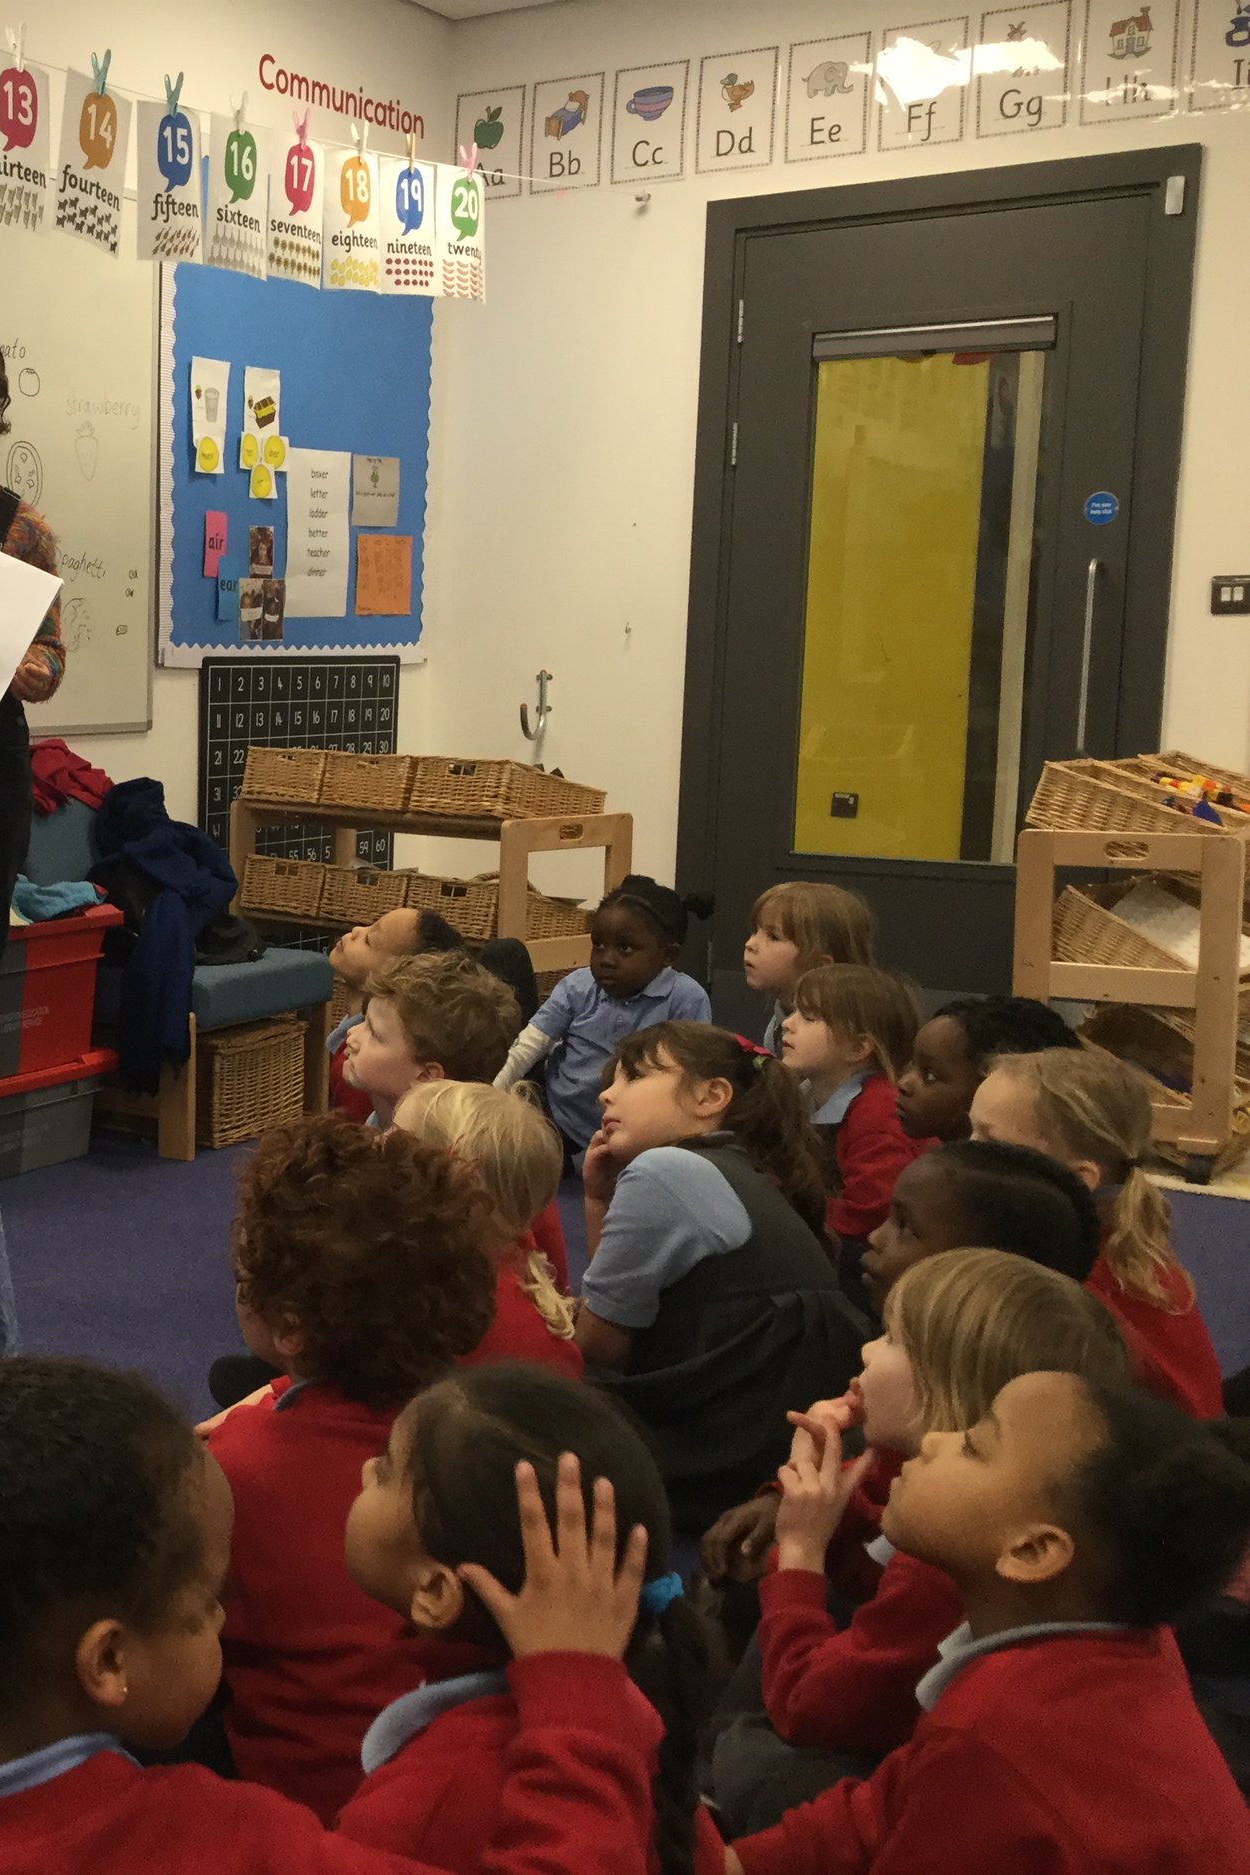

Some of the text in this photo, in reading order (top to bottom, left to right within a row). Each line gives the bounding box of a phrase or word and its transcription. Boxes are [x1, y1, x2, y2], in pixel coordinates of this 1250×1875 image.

[3, 80, 33, 126] 13
[258, 53, 425, 140] Communication
[999, 89, 1044, 126] Gg
[87, 103, 113, 149] 14
[810, 116, 842, 145] Ee
[907, 101, 938, 141] Ff
[162, 126, 190, 165] 15
[632, 139, 664, 167] Cc
[716, 126, 755, 157] Dd
[230, 141, 254, 181] 16
[289, 155, 313, 192] 17
[549, 150, 581, 178] Bb
[58, 163, 121, 212] fourteen
[345, 168, 370, 204] 18
[400, 178, 423, 212] 19
[151, 193, 199, 223] fifteen
[454, 186, 479, 221] 20
[216, 204, 261, 234] sixteen
[270, 218, 322, 245] seventeen
[331, 230, 379, 253] eighteen
[387, 238, 432, 257] nineteen
[310, 487, 329, 499] letter
[208, 534, 224, 551] air
[308, 528, 328, 538] better
[220, 578, 238, 592] ear
[217, 674, 390, 692] 1 2 3 4 5 6 7 8 9 10
[235, 713, 244, 728] 12
[255, 712, 264, 727] 13
[275, 711, 283, 726] 14
[294, 711, 302, 725] 15
[312, 710, 320, 724] 16
[331, 709, 338, 723] 17
[348, 708, 356, 722] 18
[365, 708, 373, 721] 19
[380, 707, 390, 721] 20
[214, 750, 222, 765] 21
[233, 749, 244, 764] 22
[345, 743, 355, 754] 28
[362, 742, 372, 754] 29
[379, 741, 389, 754] 30
[213, 786, 221, 801] 31
[307, 848, 316, 860] 56
[359, 841, 369, 855] 59
[375, 839, 385, 852] 60
